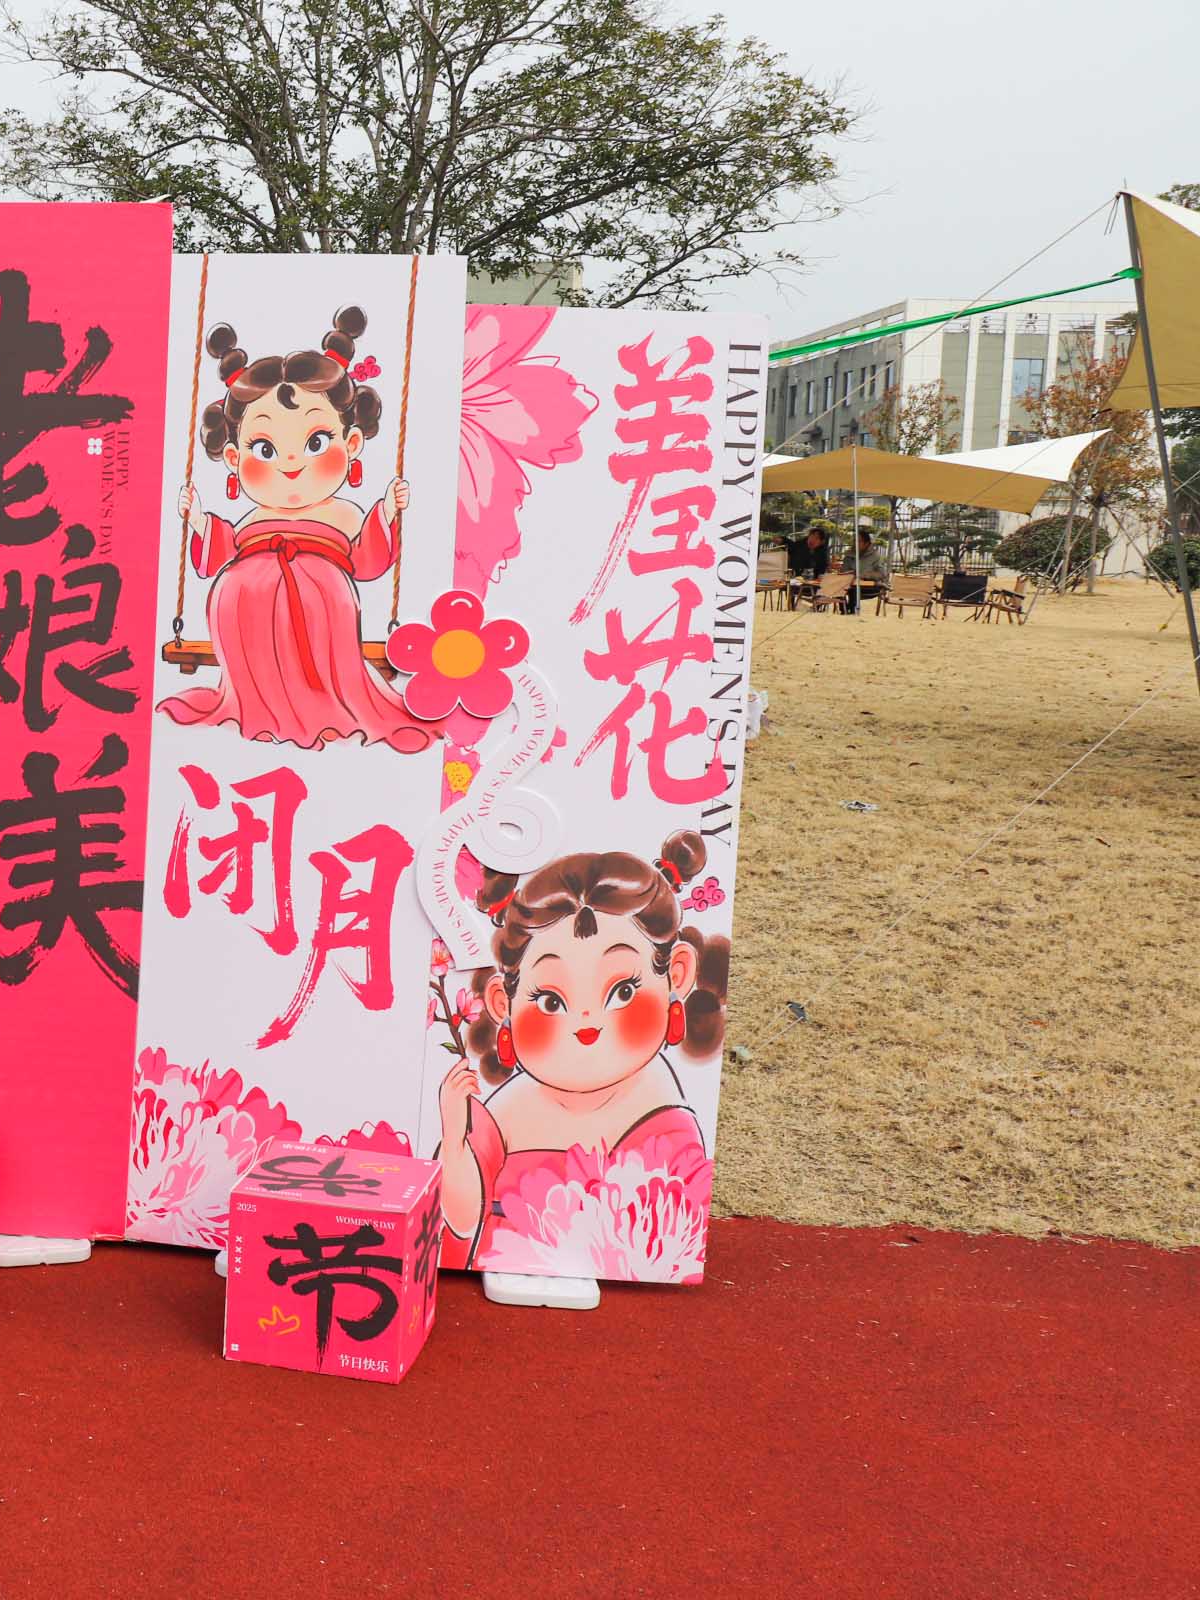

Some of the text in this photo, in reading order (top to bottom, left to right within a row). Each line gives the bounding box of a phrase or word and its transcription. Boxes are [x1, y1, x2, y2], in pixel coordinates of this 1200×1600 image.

[117, 431, 130, 490] HAPPY
[722, 341, 761, 496] HAPPY
[99, 430, 116, 555] WOMEN'S DAY
[708, 513, 752, 742] WOMEN'S
[518, 673, 548, 719] HAPPY
[491, 729, 545, 788] WOMEN'S
[435, 812, 475, 853] HAPPY
[459, 930, 481, 957] DAY
[236, 1202, 257, 1212] 2025
[263, 1222, 402, 1369] 节
[338, 1353, 389, 1374] 节日快乐
